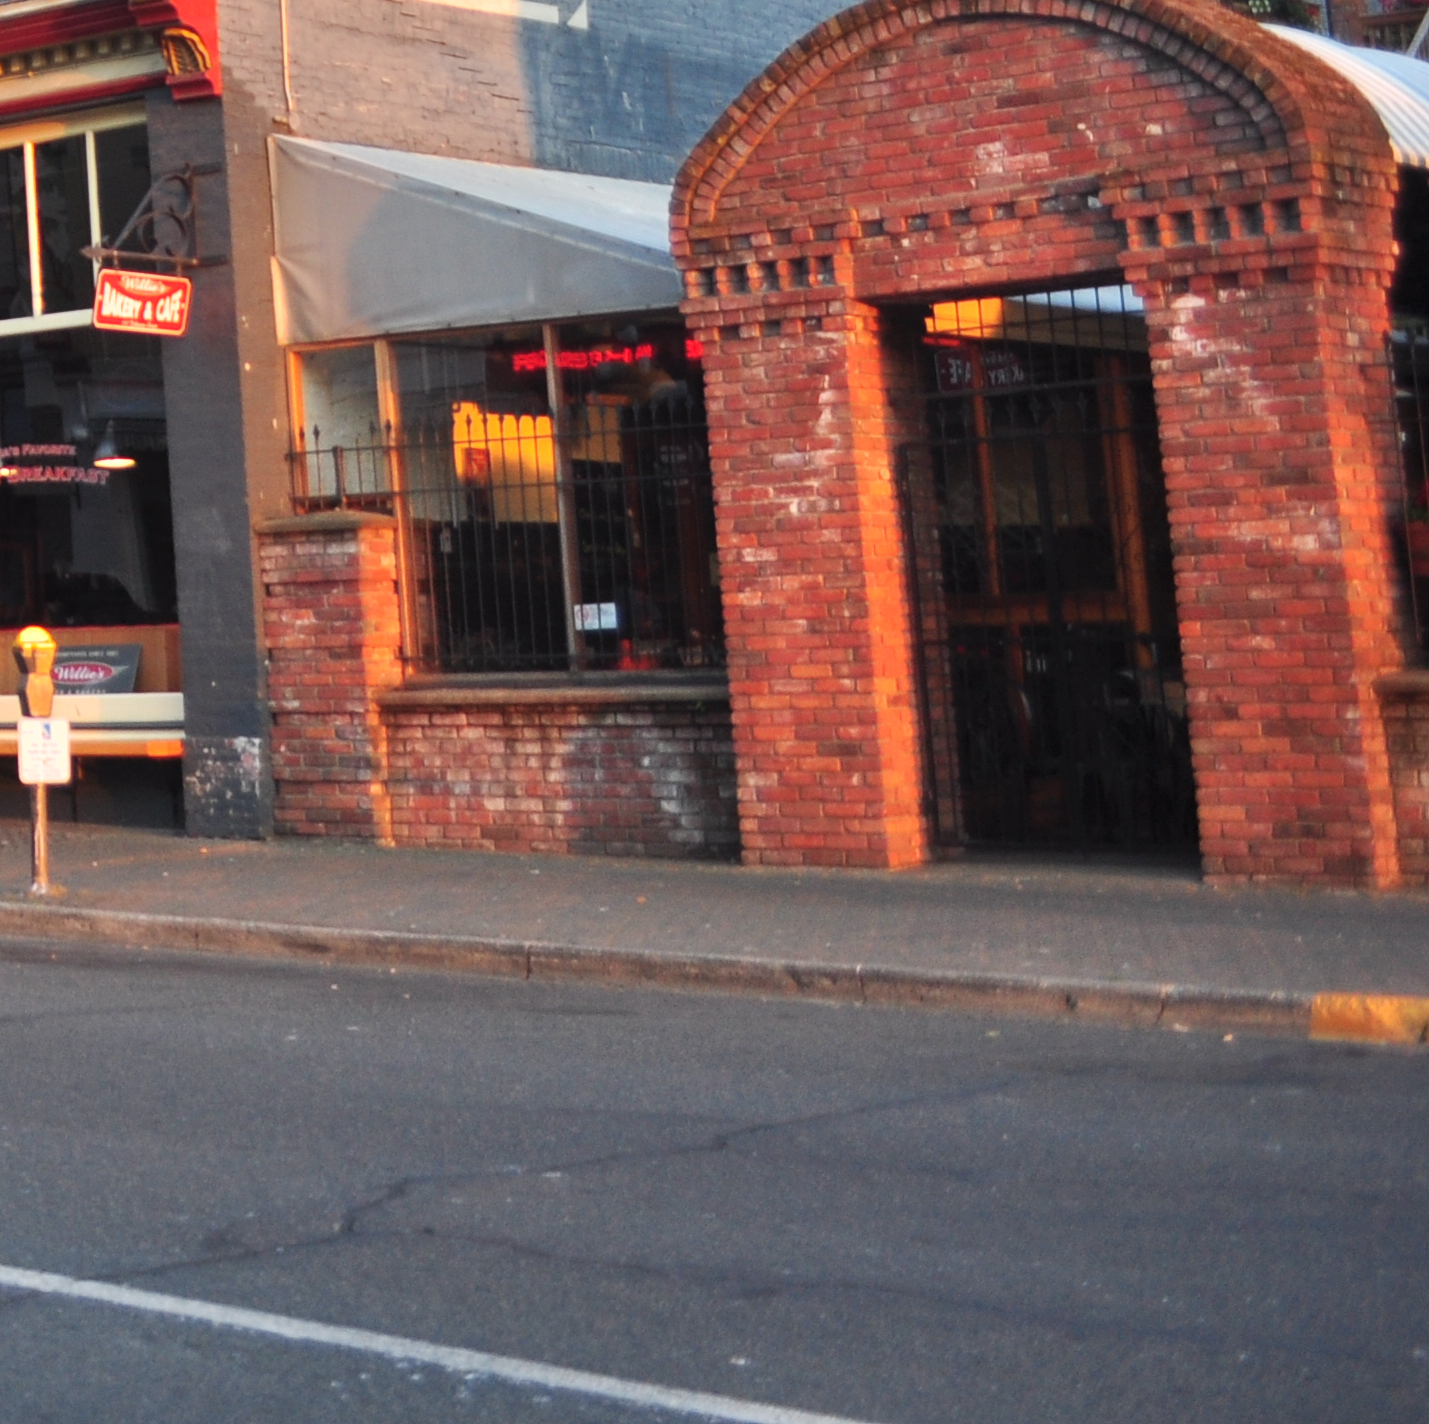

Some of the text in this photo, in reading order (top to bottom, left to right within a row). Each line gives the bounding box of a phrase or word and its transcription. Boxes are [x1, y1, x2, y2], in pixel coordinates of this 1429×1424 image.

[101, 281, 142, 320] BAKERY
[143, 301, 153, 321] &
[6, 465, 110, 485] BREAKFAST
[53, 665, 106, 680] Willie's
